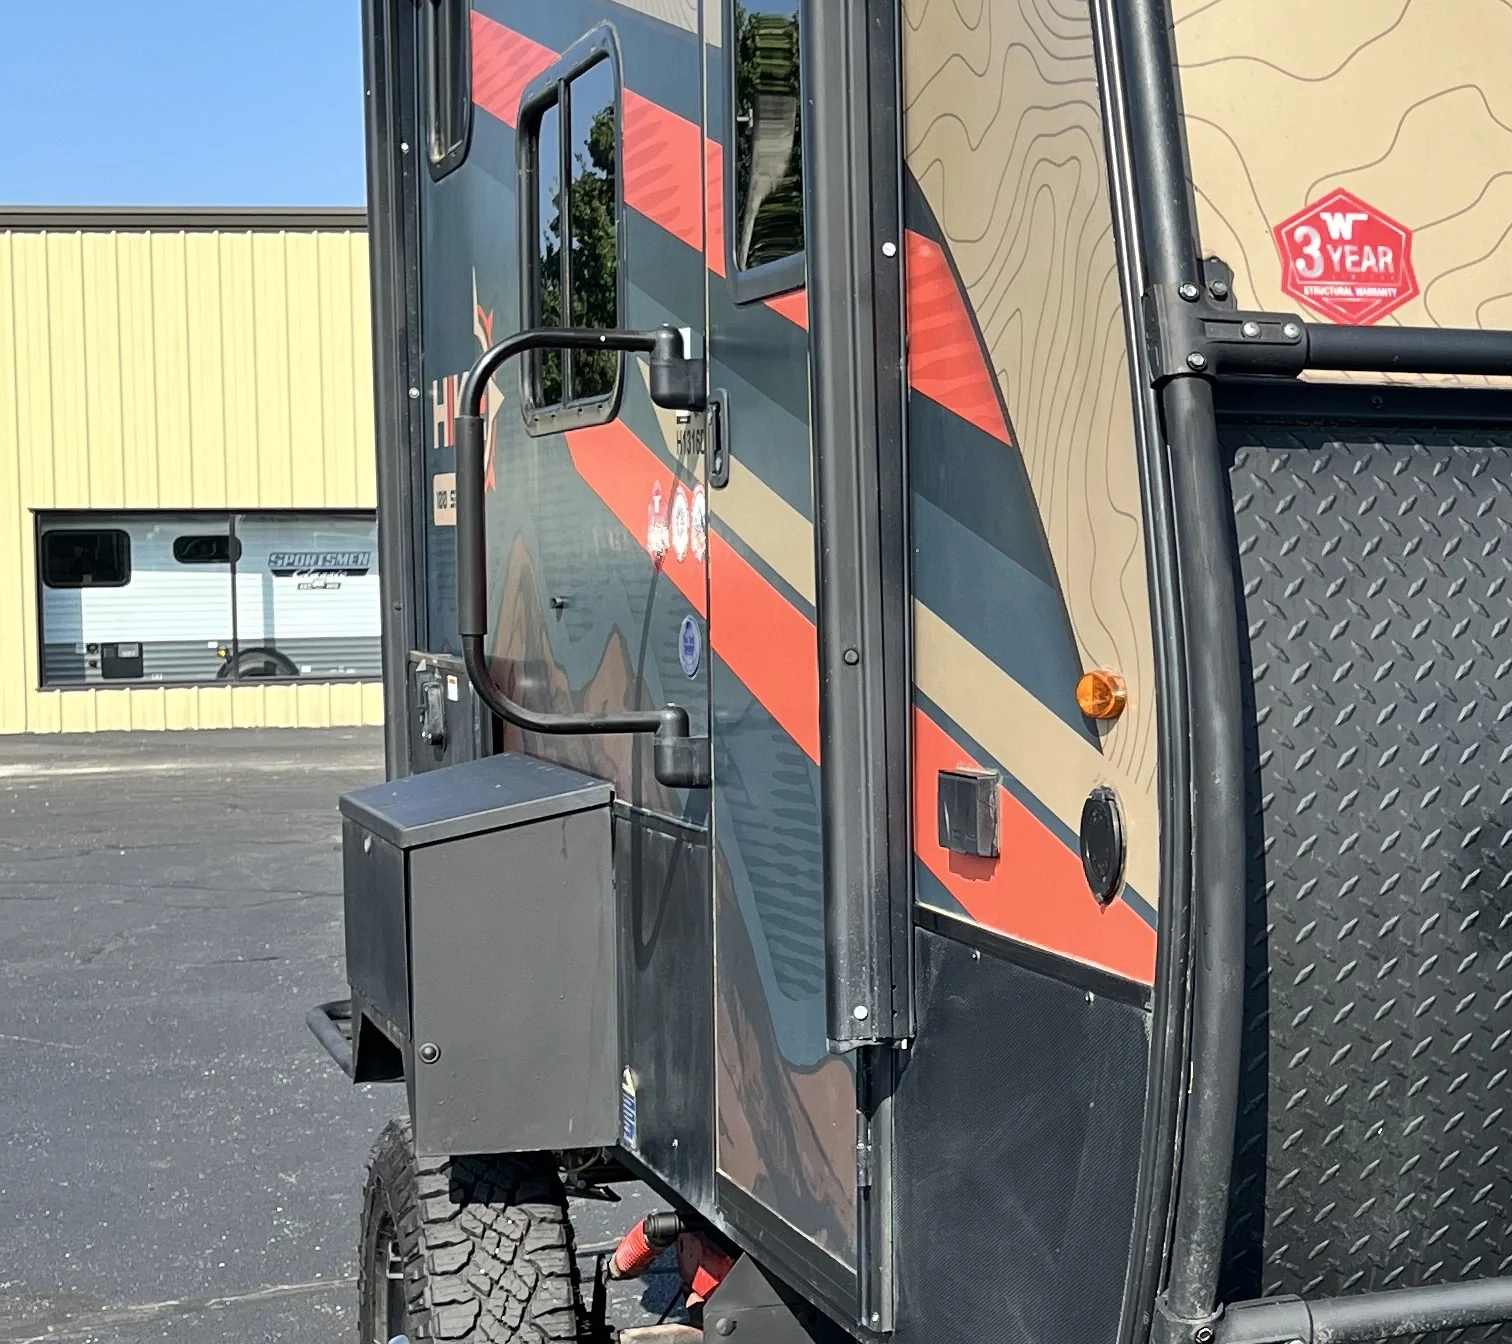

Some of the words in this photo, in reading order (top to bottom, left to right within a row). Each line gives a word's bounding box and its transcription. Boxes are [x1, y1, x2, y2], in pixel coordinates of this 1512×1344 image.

[1293, 225, 1324, 278] 3
[1326, 244, 1395, 273] YEAR
[1303, 285, 1354, 296] STRUCTURAL
[1355, 287, 1397, 297] WARRANTY
[269, 553, 370, 567] SPORTSMEN
